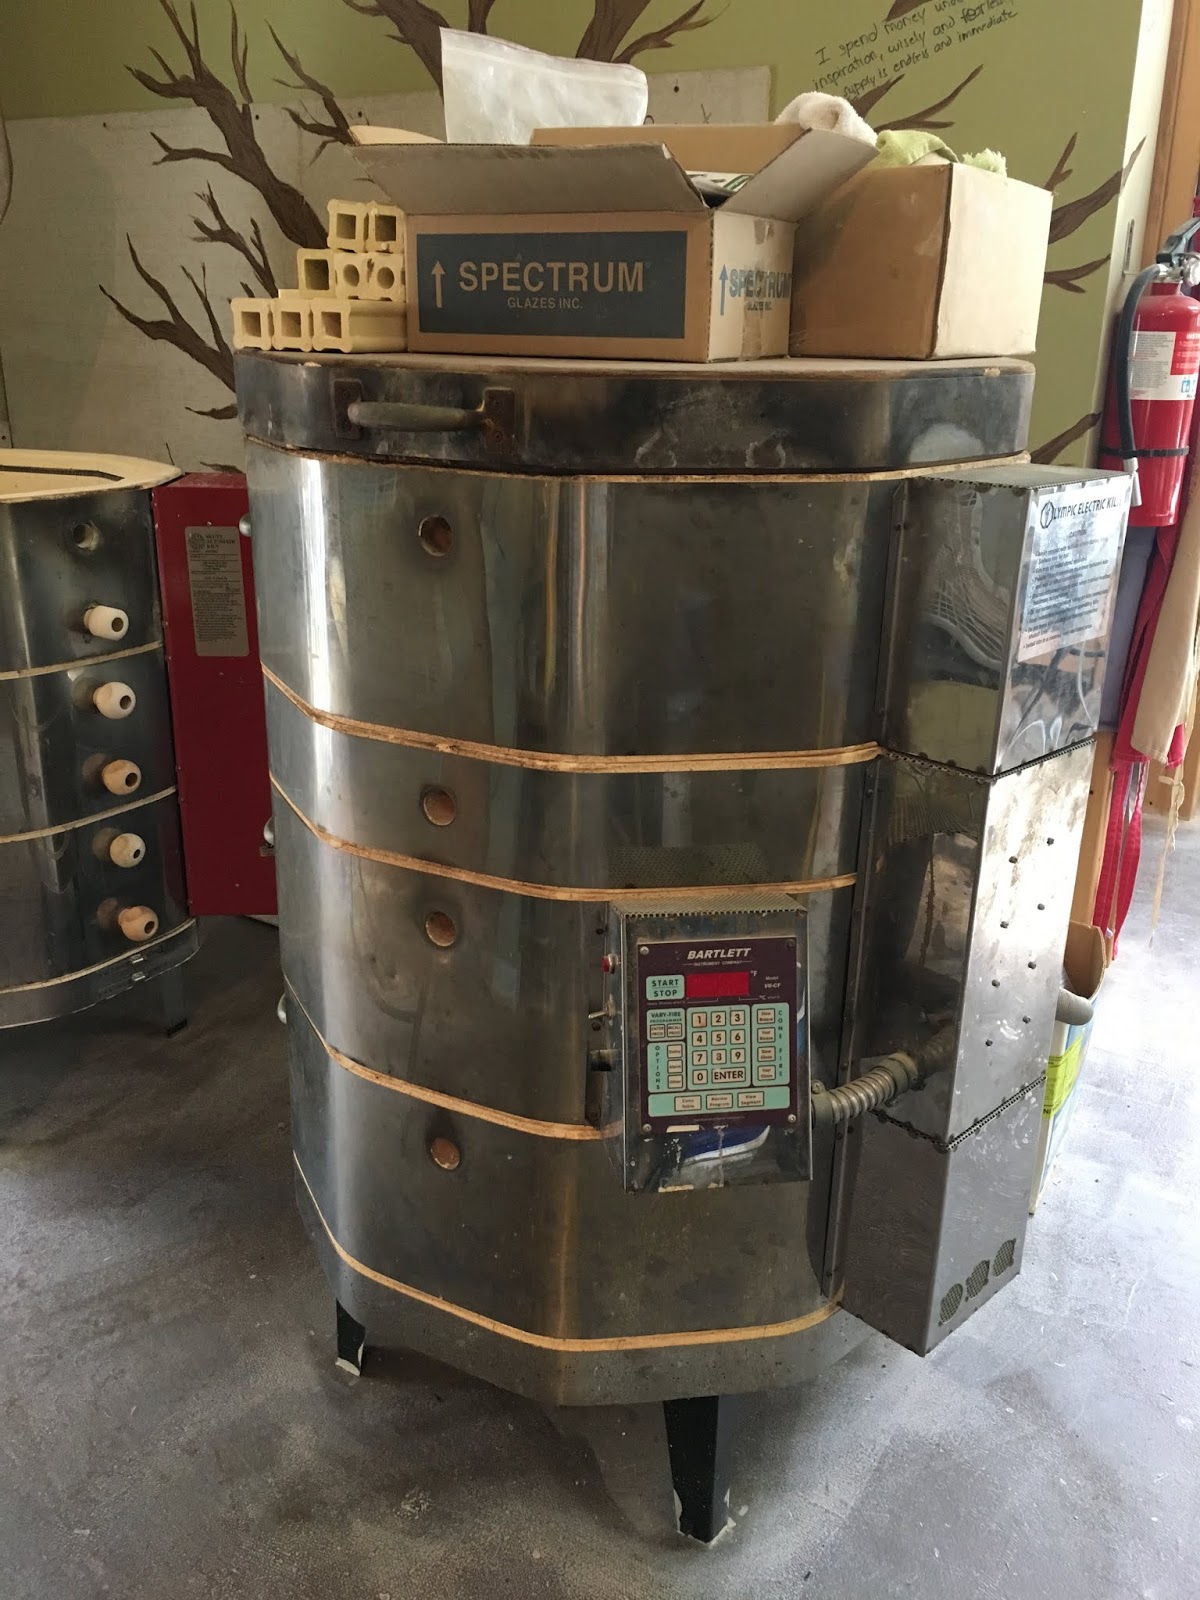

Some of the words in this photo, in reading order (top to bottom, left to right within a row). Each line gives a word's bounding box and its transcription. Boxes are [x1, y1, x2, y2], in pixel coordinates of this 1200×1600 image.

[815, 46, 831, 66] I
[838, 23, 878, 58] spend
[884, 8, 925, 34] money
[888, 31, 925, 52] wisely
[933, 16, 955, 36] and
[843, 75, 876, 97] supply
[878, 68, 888, 79] is
[893, 48, 929, 72] endless
[933, 35, 952, 53] and
[957, 9, 1019, 42] immediate
[459, 261, 644, 292] SPECTRUM
[507, 297, 556, 309] GLAZES
[559, 297, 583, 309] INC.
[1077, 498, 1107, 515] ELECTRIC
[687, 948, 751, 960] BARTLETT
[697, 1016, 702, 1024] 1
[716, 1014, 721, 1023] 2
[735, 1014, 740, 1022] 3
[735, 1033, 740, 1041] 6
[697, 1054, 703, 1062] 7
[697, 1073, 703, 1081] 0
[714, 1070, 744, 1080] ENTER
